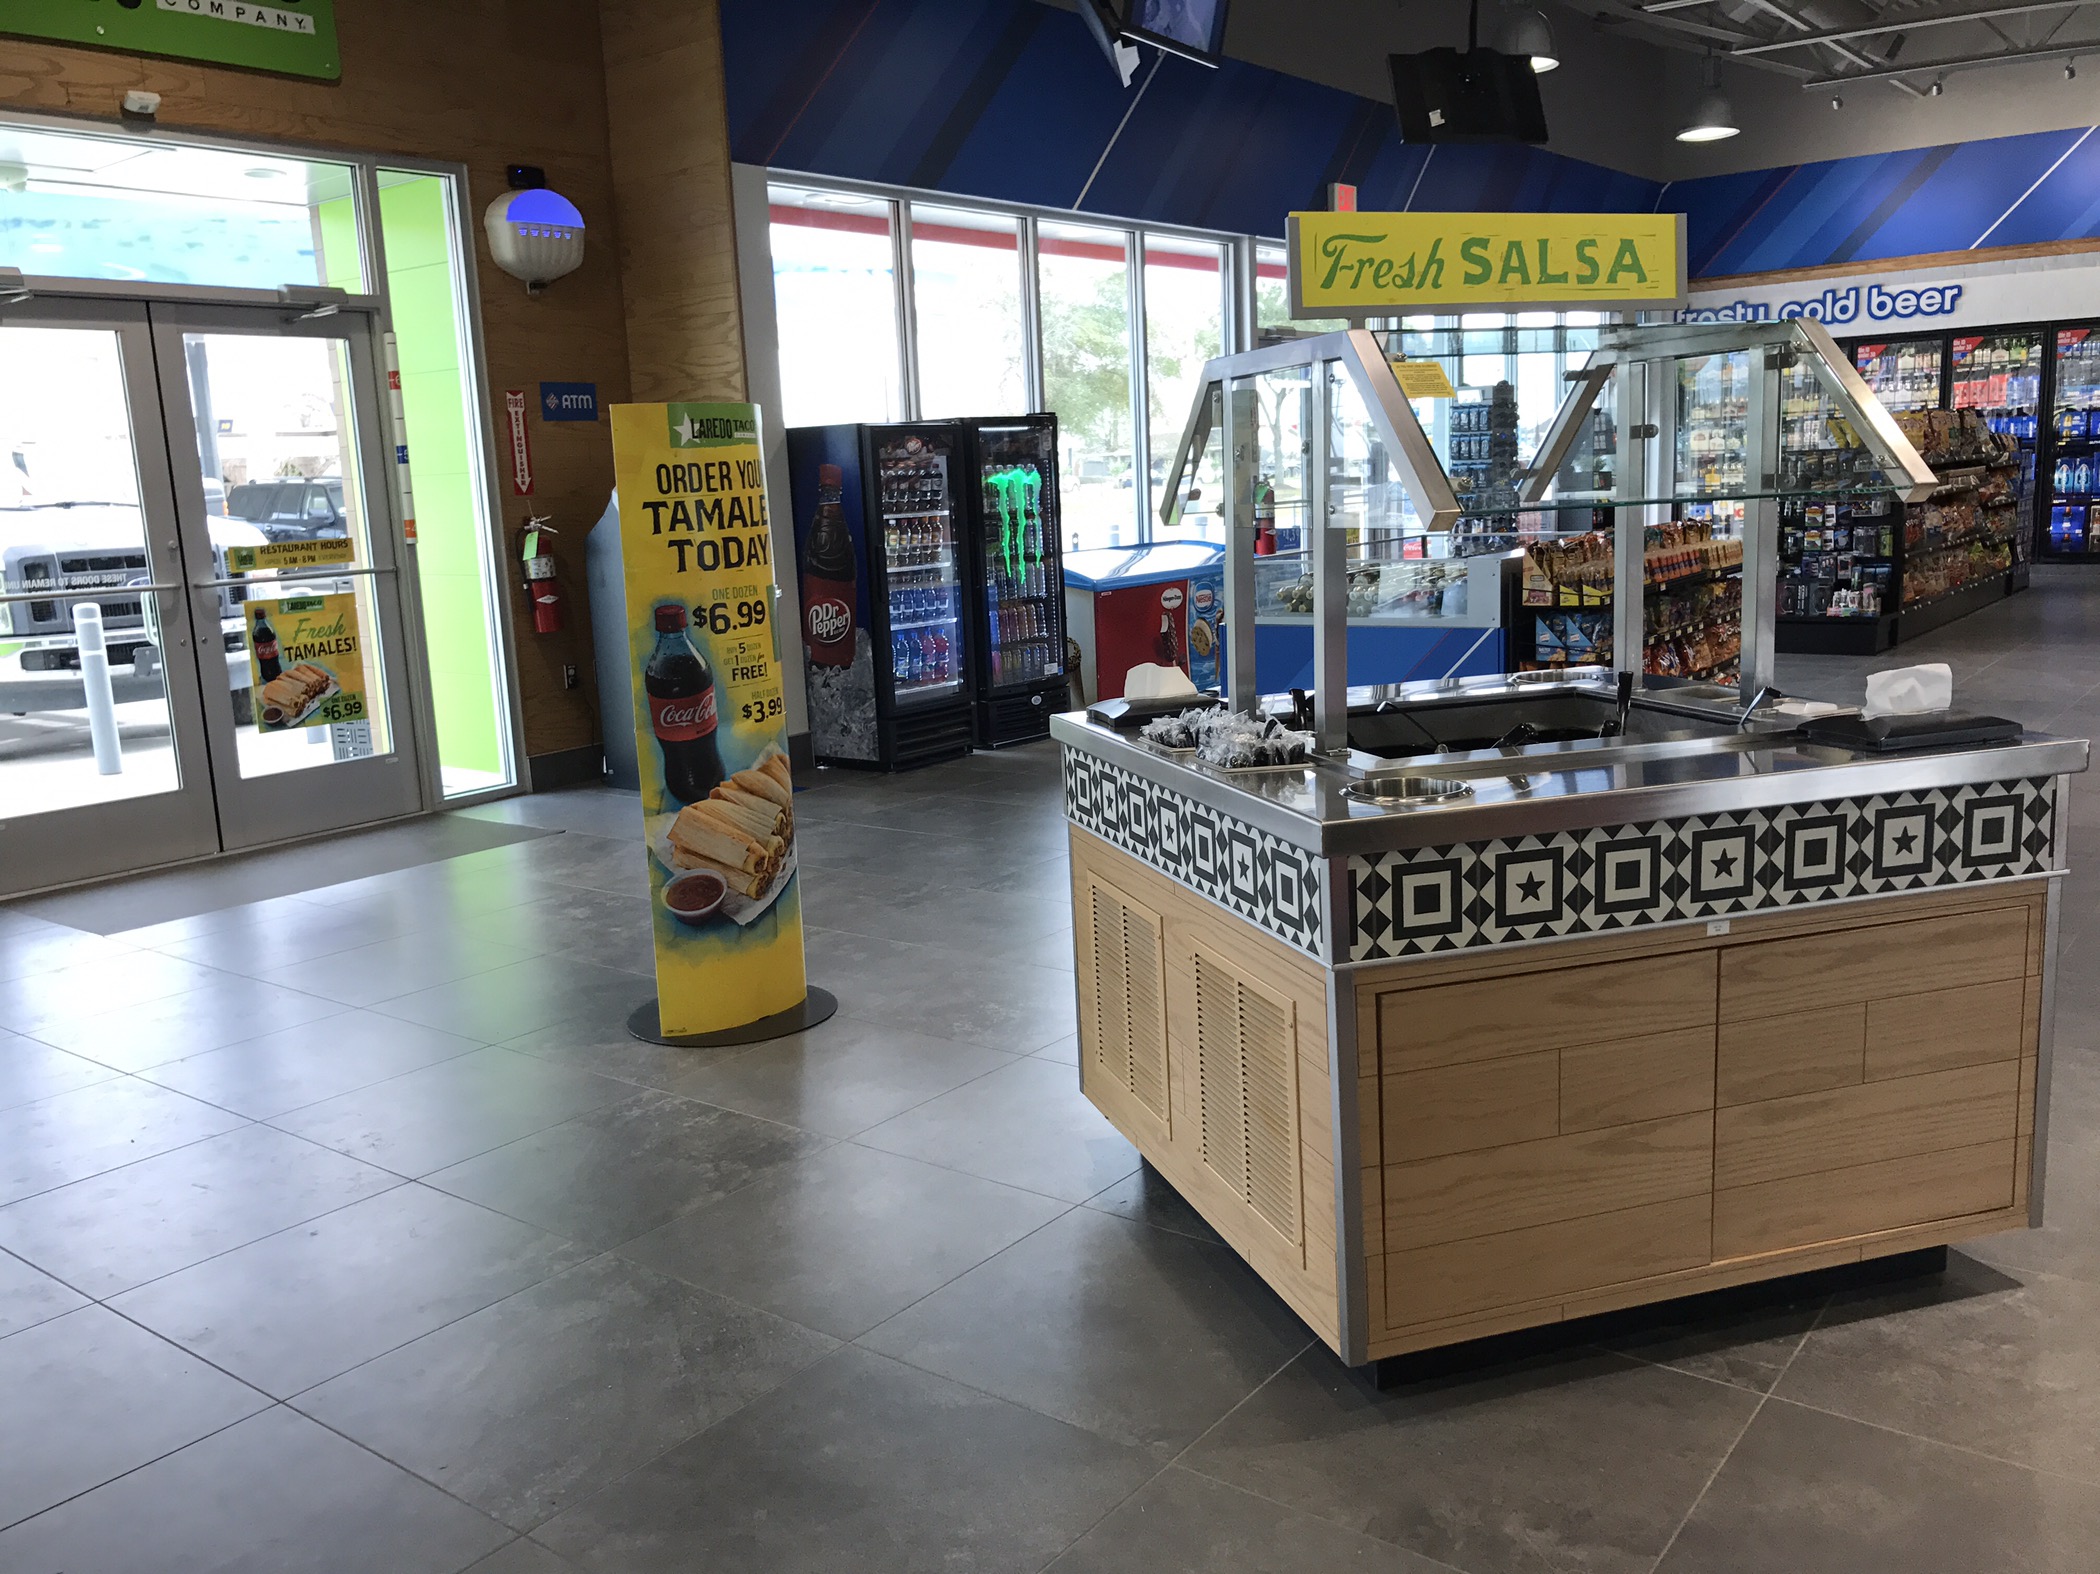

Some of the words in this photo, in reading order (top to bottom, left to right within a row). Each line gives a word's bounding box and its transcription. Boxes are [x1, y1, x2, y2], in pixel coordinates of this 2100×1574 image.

[1320, 232, 1445, 289] Fresh
[1461, 236, 1648, 286] SALSA
[1779, 286, 1859, 325] cold
[1867, 284, 1962, 320] beer
[508, 398, 523, 408] FIRE
[561, 394, 593, 410] ATM
[691, 418, 733, 439] LAREDO
[733, 419, 755, 433] TACO
[514, 410, 527, 486] EXTINGUISHER
[655, 460, 732, 495] ORDER
[260, 542, 317, 555] RESTAURANT
[320, 539, 348, 549] HOURS
[667, 533, 769, 573] TODAY
[283, 557, 288, 565] 5
[289, 556, 298, 564] AM
[712, 587, 730, 600] ONE
[732, 585, 758, 599] DOZEN
[692, 600, 766, 634] $6.99
[809, 605, 849, 638] Pepper
[822, 603, 839, 620] Dr
[293, 612, 346, 643] Fresh
[284, 636, 357, 662] TAMALES!
[738, 642, 746, 654] 5
[735, 655, 739, 666] 1
[732, 662, 768, 681] FREE!
[752, 690, 765, 700] HALF
[322, 701, 362, 720] $6.99
[742, 697, 783, 723] $3.99
